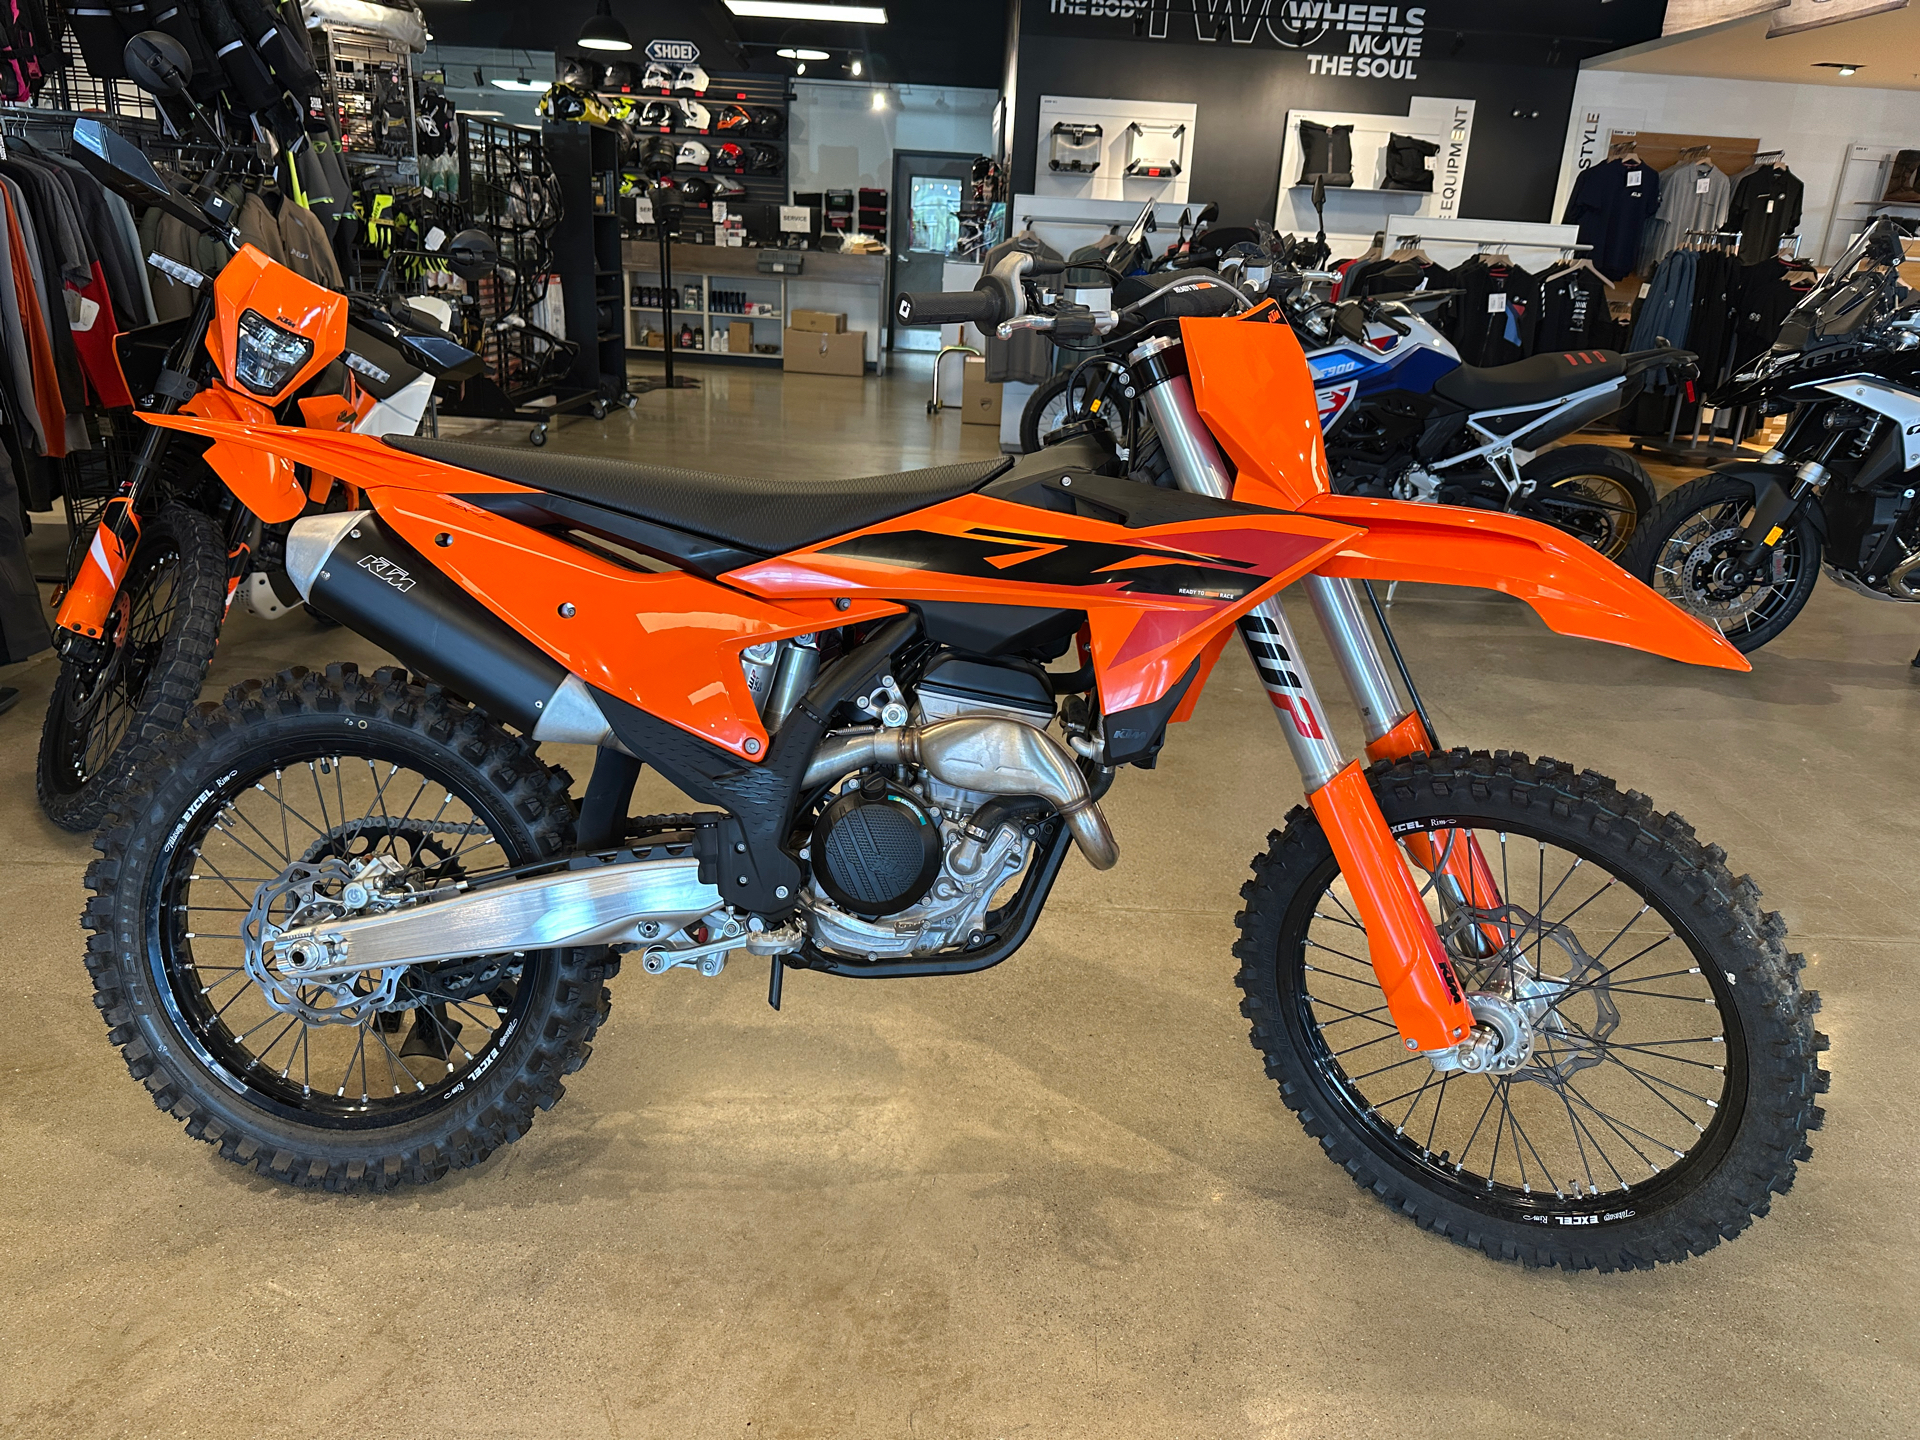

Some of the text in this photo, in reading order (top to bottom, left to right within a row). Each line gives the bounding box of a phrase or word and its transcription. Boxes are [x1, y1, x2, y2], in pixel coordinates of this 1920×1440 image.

[1050, 0, 1148, 18] THE BODY
[1289, 0, 1427, 35] WHEELS
[653, 44, 692, 59] SHOEI
[1348, 34, 1423, 57] MOVE
[1307, 54, 1418, 80] THE SOUL
[1440, 106, 1468, 210] EQUIPMENT
[783, 215, 808, 223] SERVICE
[276, 315, 296, 328] KTM
[1267, 309, 1281, 323] KTM
[357, 554, 417, 593] KTM
[1113, 728, 1148, 740] KTM
[182, 789, 215, 823] EXCEL
[215, 769, 238, 788] Rim
[1389, 818, 1457, 833] XCEL Rim
[1438, 961, 1462, 1004] KTM
[467, 1047, 500, 1081] EXCEL
[443, 1081, 465, 1099] Rim
[1522, 1214, 1548, 1224] Rim
[1554, 1214, 1600, 1225] EXCEL
